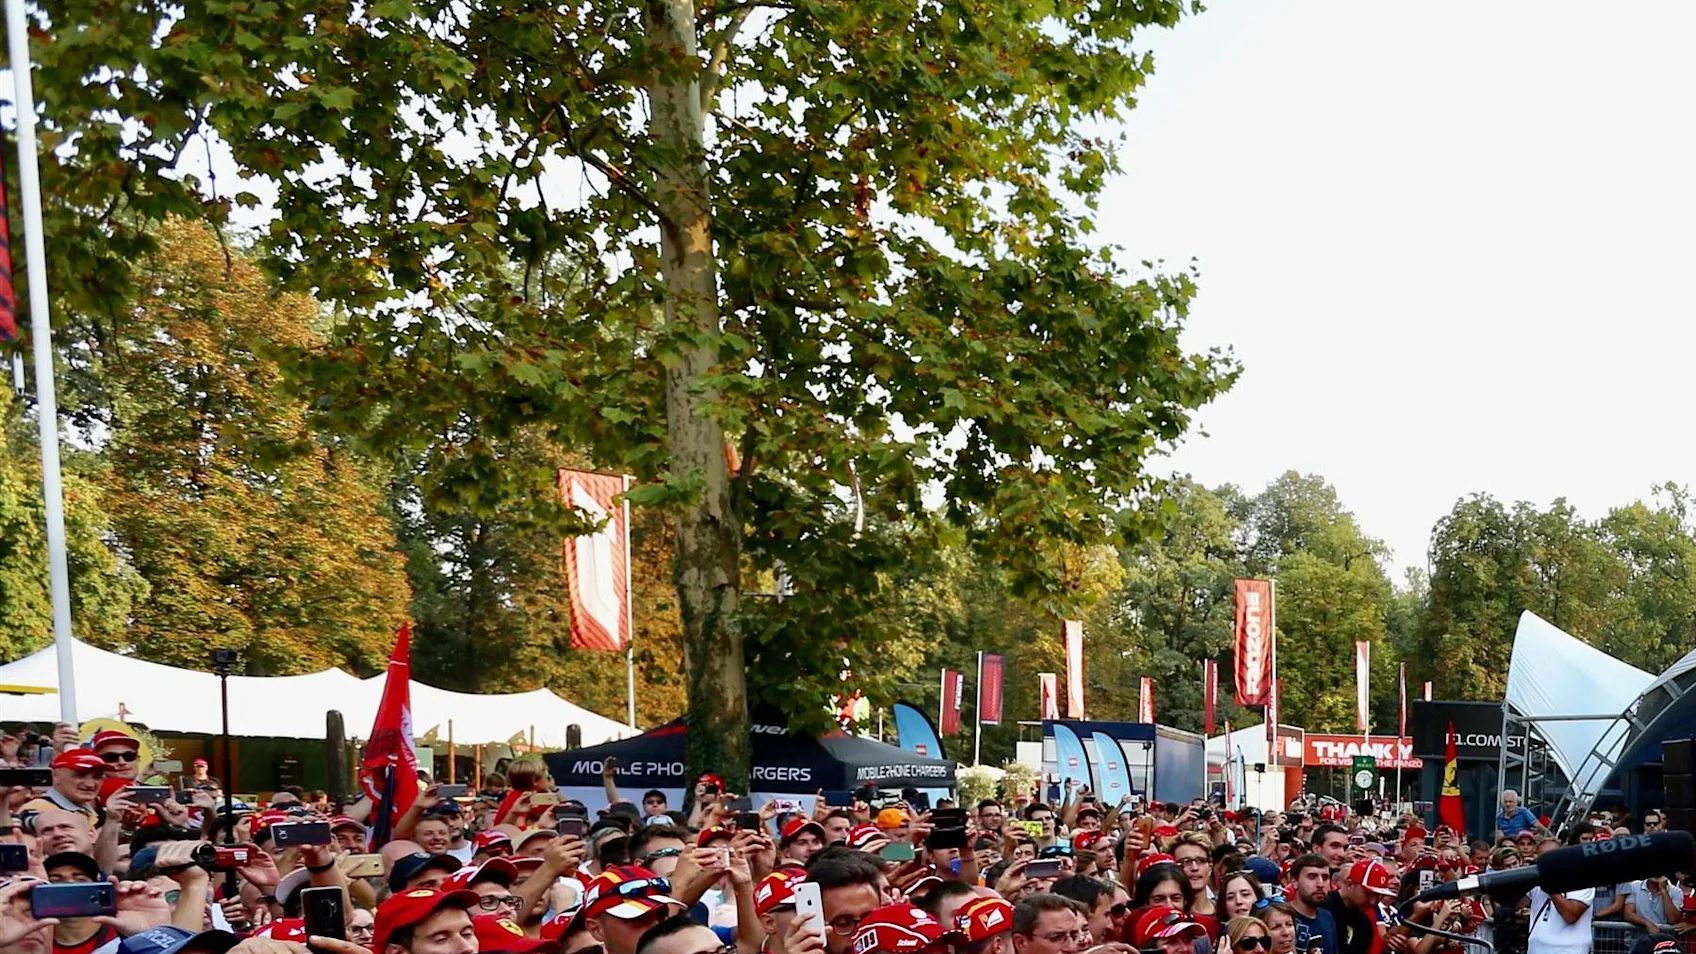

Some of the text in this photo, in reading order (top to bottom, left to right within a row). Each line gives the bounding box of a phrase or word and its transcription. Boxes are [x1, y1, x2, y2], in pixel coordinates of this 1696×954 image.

[1312, 741, 1393, 759] THANK
[646, 762, 687, 776] PHO
[1319, 758, 1338, 766] FOR
[1375, 759, 1392, 767] THE
[1394, 759, 1423, 768] FANZO
[856, 764, 948, 780] MOBILE PHONE CHARGERS
